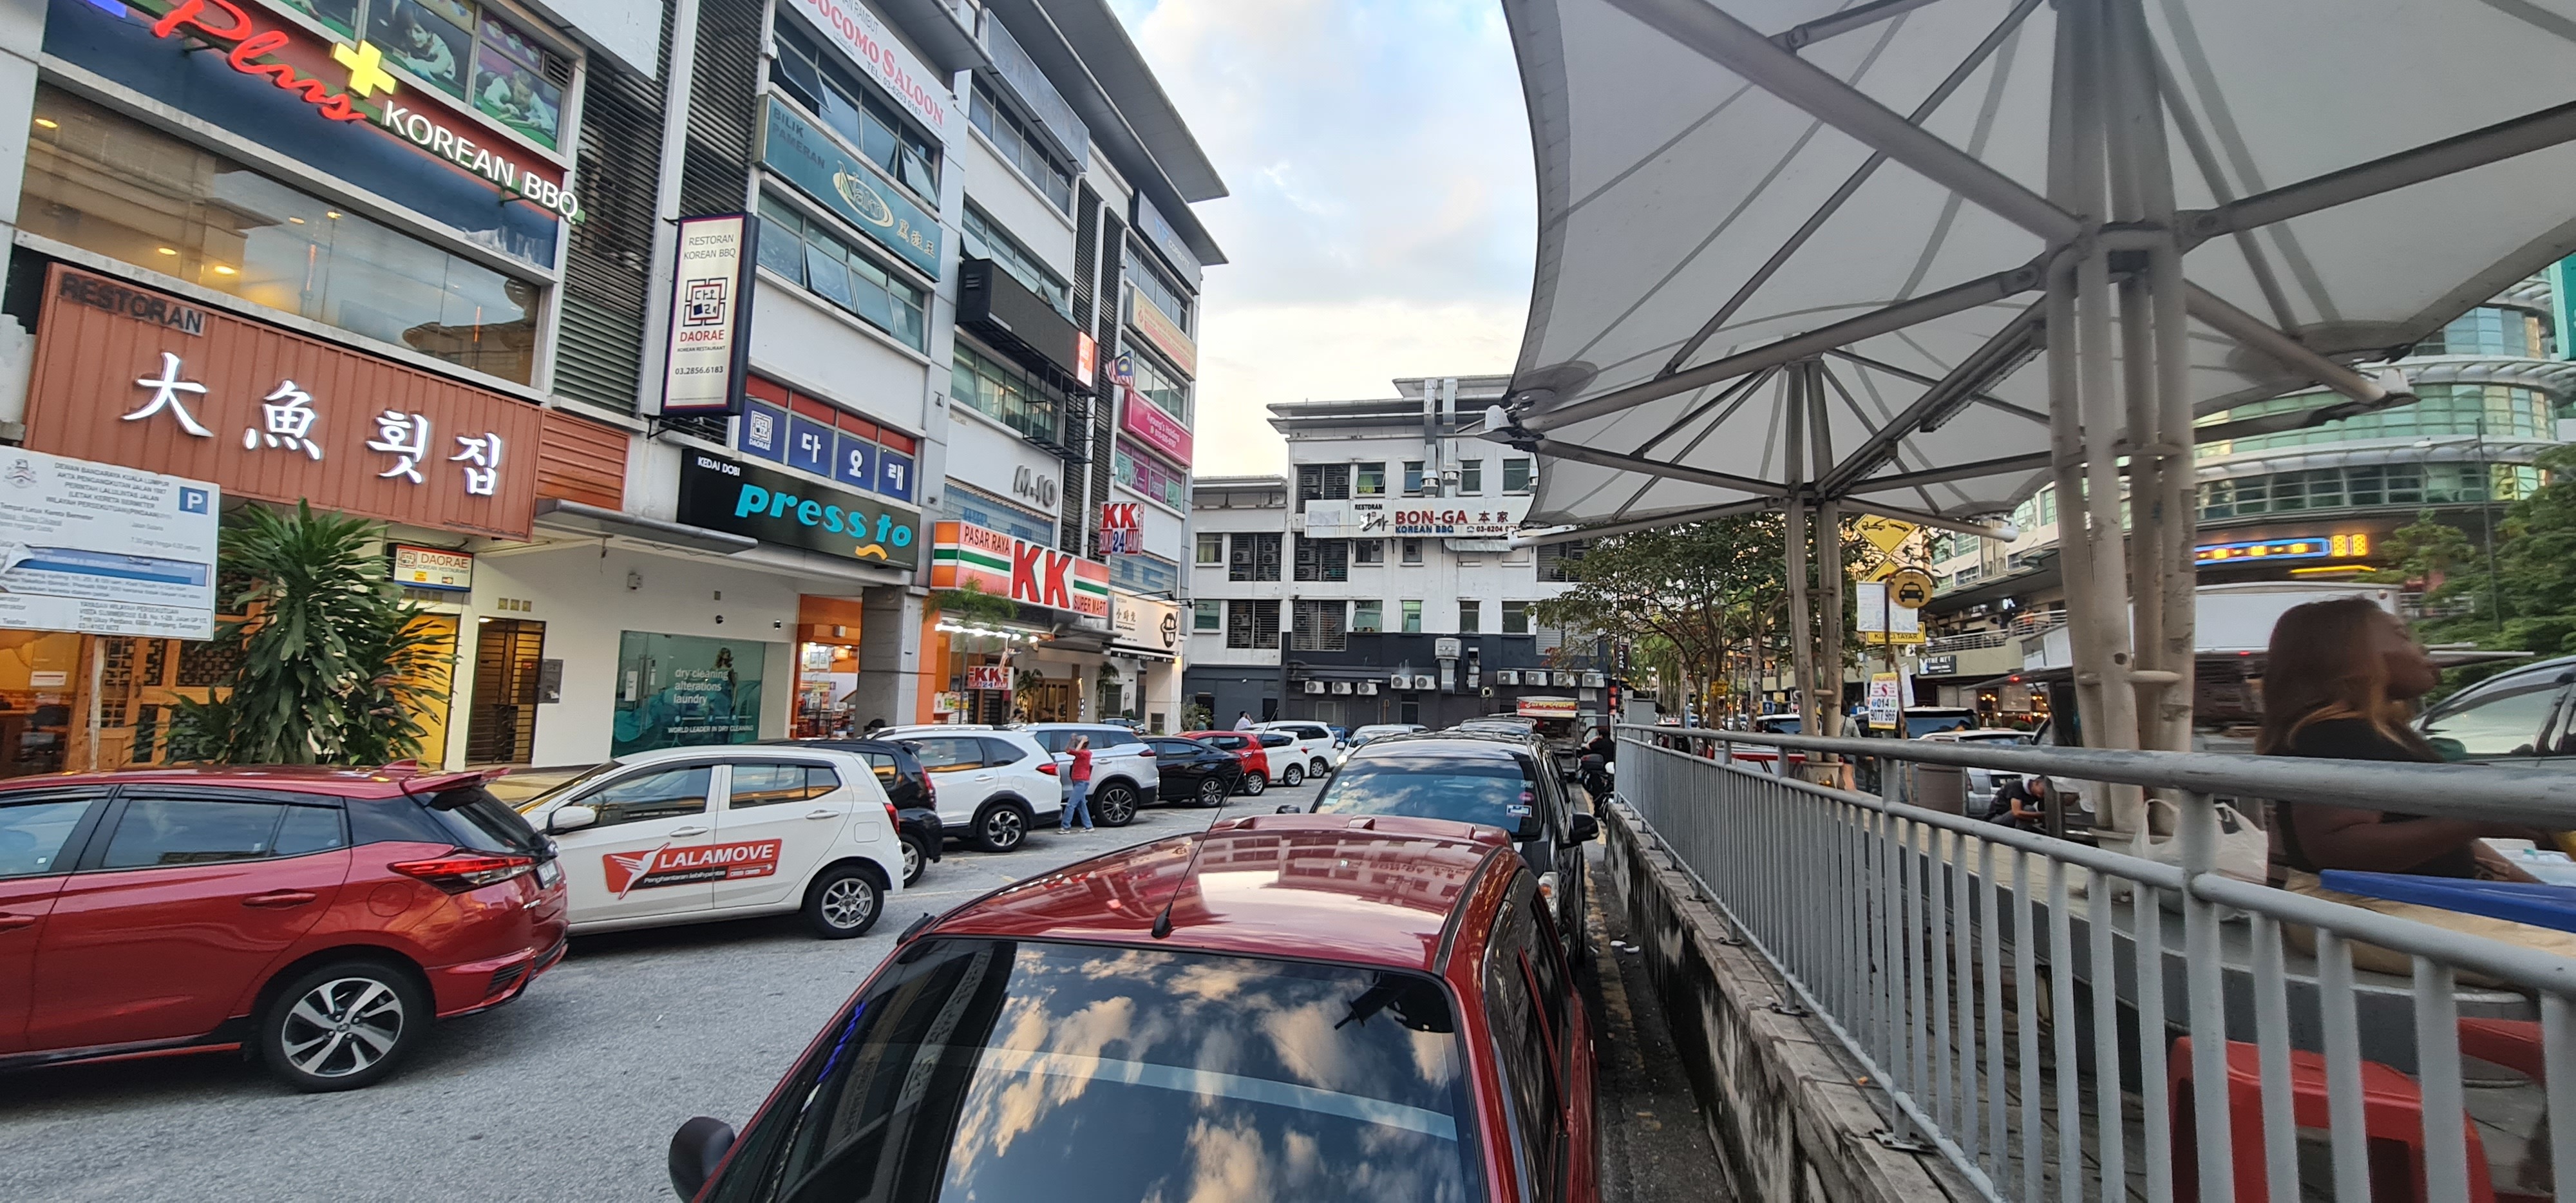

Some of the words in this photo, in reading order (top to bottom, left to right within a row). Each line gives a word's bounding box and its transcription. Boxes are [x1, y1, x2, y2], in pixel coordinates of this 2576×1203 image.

[853, 1, 879, 35] RAMBUT
[152, 0, 366, 122] Plus
[807, 0, 880, 63] OCOMO
[882, 49, 944, 126] SALOON
[867, 60, 882, 82] TEL:
[773, 107, 804, 138] BILIK
[773, 122, 825, 169] PAMERAN
[383, 99, 515, 188] KOREAN
[522, 171, 582, 225] BBQ
[688, 234, 734, 245] RESTORAN
[683, 251, 716, 260] KOREAN
[719, 247, 736, 258] BBQ
[60, 274, 203, 334] RESTORAN
[680, 329, 724, 342] DAORAE
[675, 366, 723, 375] 03.2856.6183
[122, 352, 324, 461] 大魚
[366, 410, 504, 497] 횟집
[749, 438, 770, 451] DAORAE
[697, 456, 720, 471] KEDAI
[721, 463, 741, 477] DOBI
[187, 492, 202, 509] P
[735, 484, 867, 538] press
[876, 513, 912, 547] to
[1102, 503, 1137, 528] KK
[1395, 510, 1468, 525] BON-GA
[1478, 510, 1508, 524] 本家
[1395, 525, 1432, 534] KOREAN
[1435, 525, 1454, 533] BBQ
[964, 526, 990, 549] PASAR
[992, 536, 1010, 554] RAYA
[1113, 531, 1124, 553] 24
[421, 554, 468, 568] DAORAE
[1012, 540, 1073, 609] KK
[1074, 594, 1090, 611] SUPER
[676, 668, 690, 679] dry
[692, 668, 729, 681] cleaning
[975, 667, 1002, 681] KK
[675, 681, 722, 691] alterations
[674, 694, 708, 704] laundry
[1877, 698, 1889, 707] 014
[1870, 709, 1884, 721] 9077
[659, 844, 774, 869] LALAMOVE
